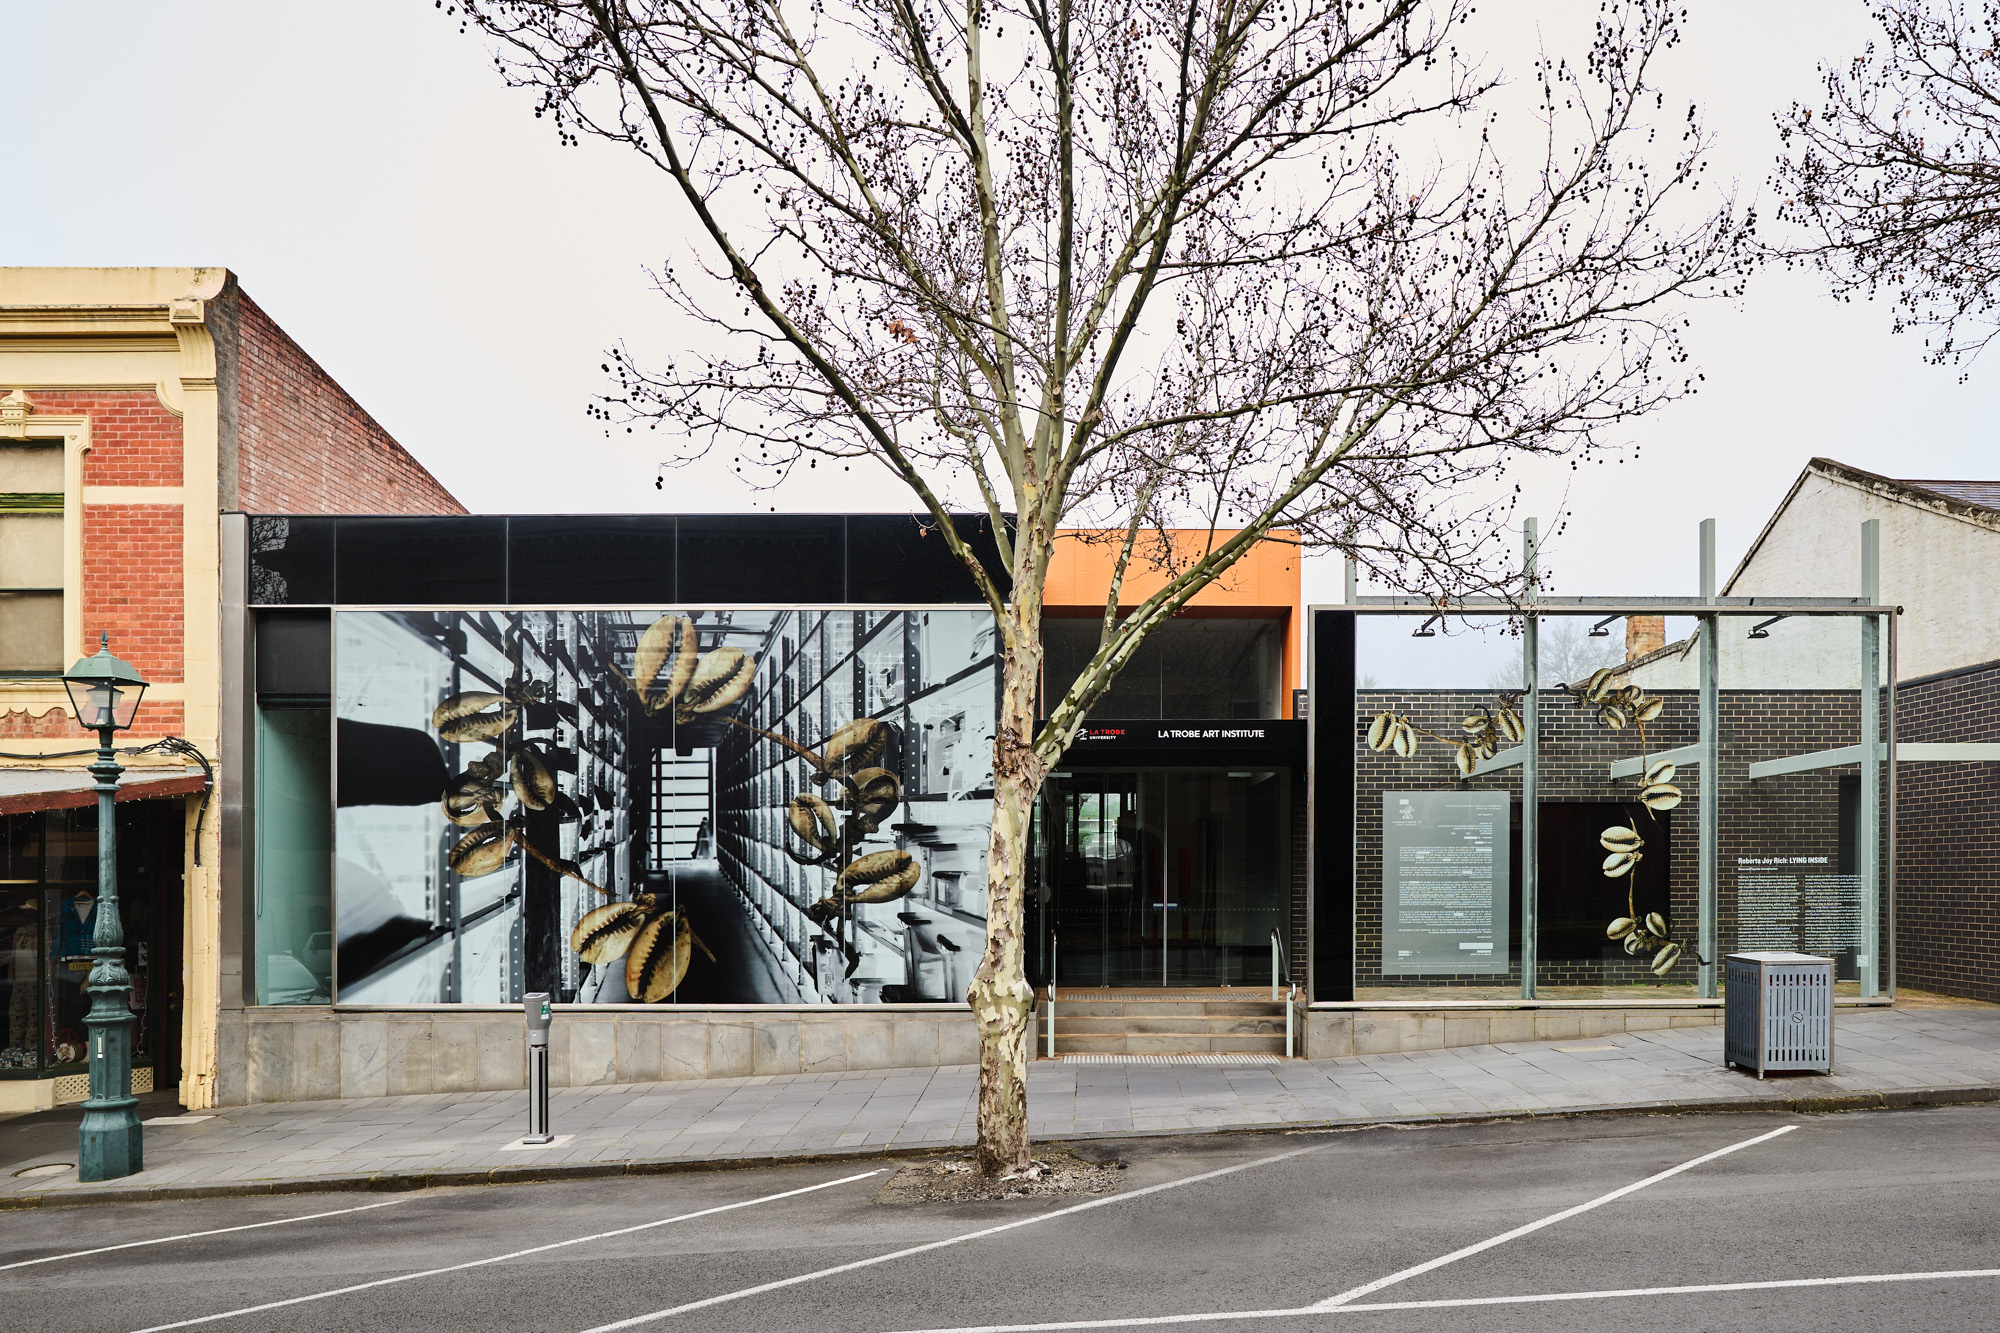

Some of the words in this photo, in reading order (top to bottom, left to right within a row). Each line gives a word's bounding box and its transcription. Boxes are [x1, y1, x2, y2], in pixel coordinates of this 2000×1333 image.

[1158, 730, 1169, 738] LA
[1170, 730, 1200, 738] TROBE
[1202, 730, 1220, 738] ART
[1221, 730, 1265, 738] INSTITUTE
[1762, 857, 1772, 865] Joy
